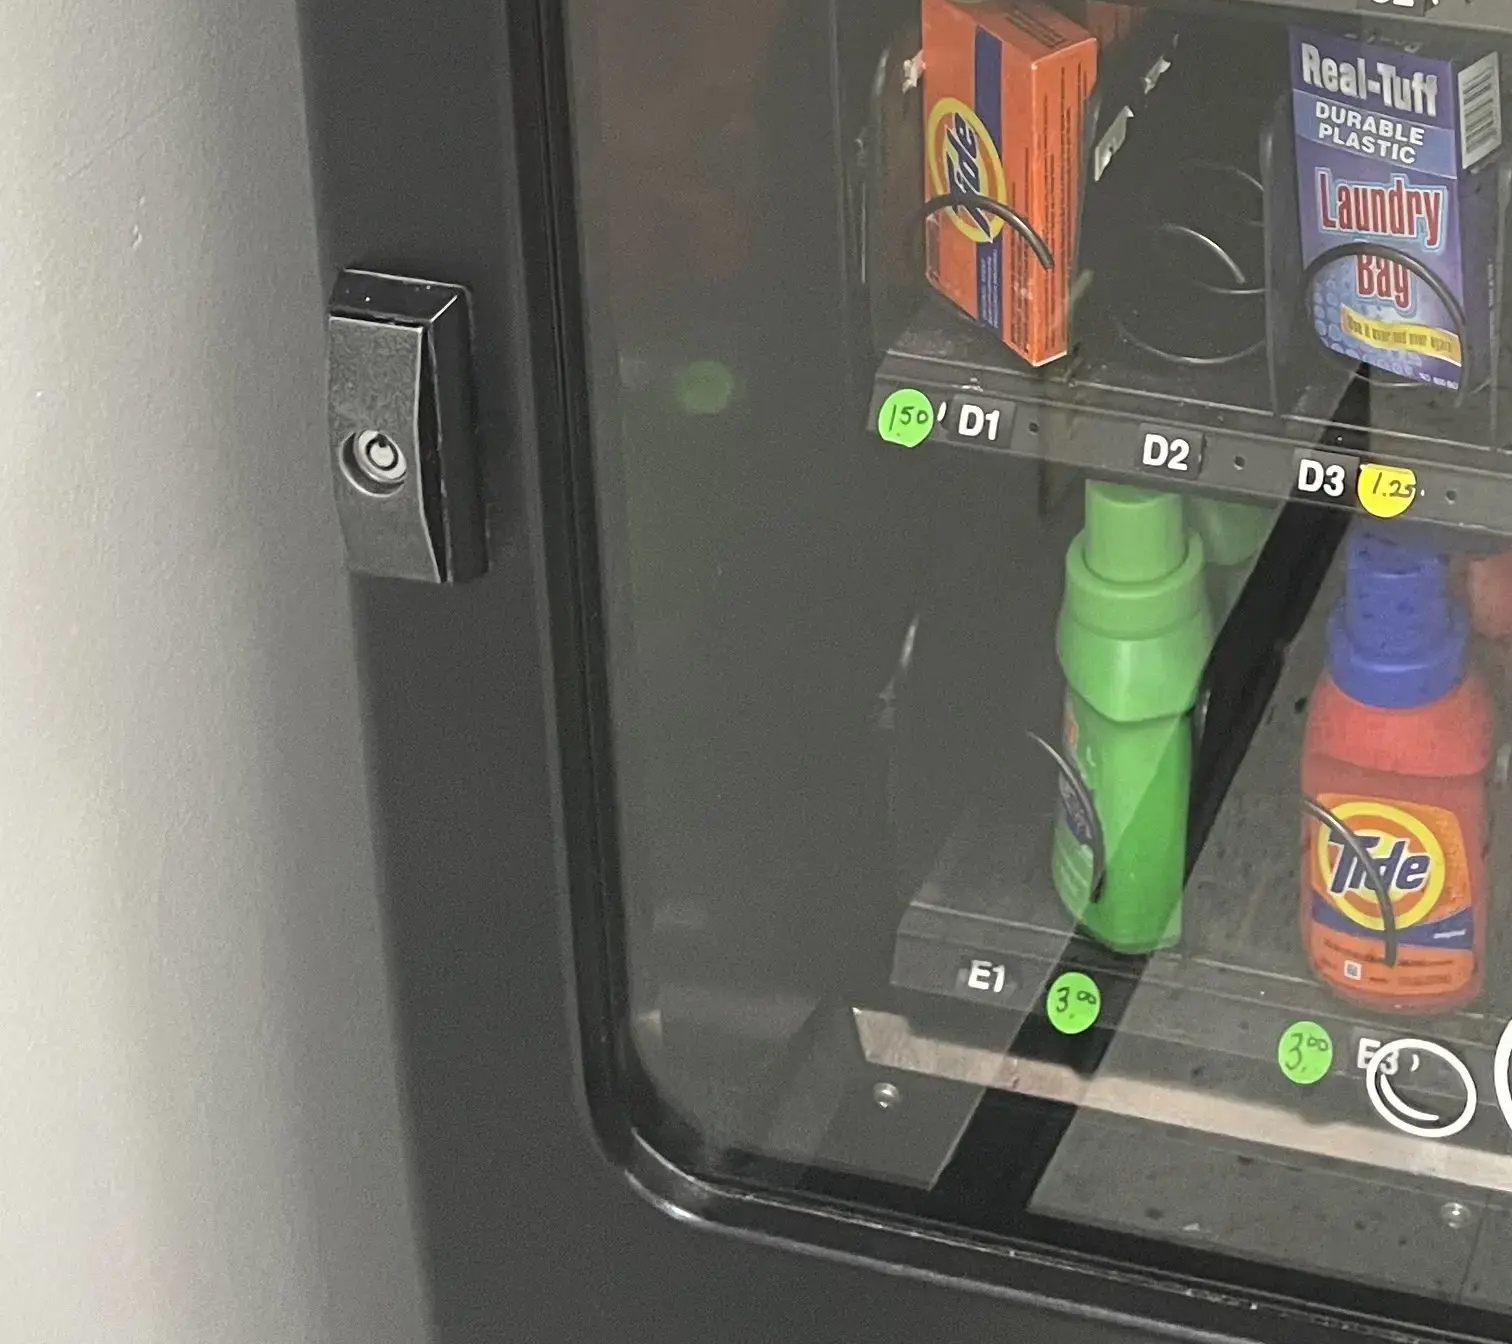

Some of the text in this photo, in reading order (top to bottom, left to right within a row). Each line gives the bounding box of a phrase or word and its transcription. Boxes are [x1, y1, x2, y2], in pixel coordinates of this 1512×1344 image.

[1301, 42, 1438, 117] Real-Tuff
[1314, 99, 1425, 146] DURABLE
[1317, 124, 1416, 165] PLASTIC
[1319, 172, 1442, 246] Laundry
[1355, 253, 1411, 310] Bag
[957, 404, 1001, 440] D1
[1142, 434, 1190, 471] D2
[1298, 459, 1346, 498] D3
[1372, 472, 1414, 499] 1.25
[1327, 833, 1433, 896] Tide
[966, 958, 1007, 993] E1
